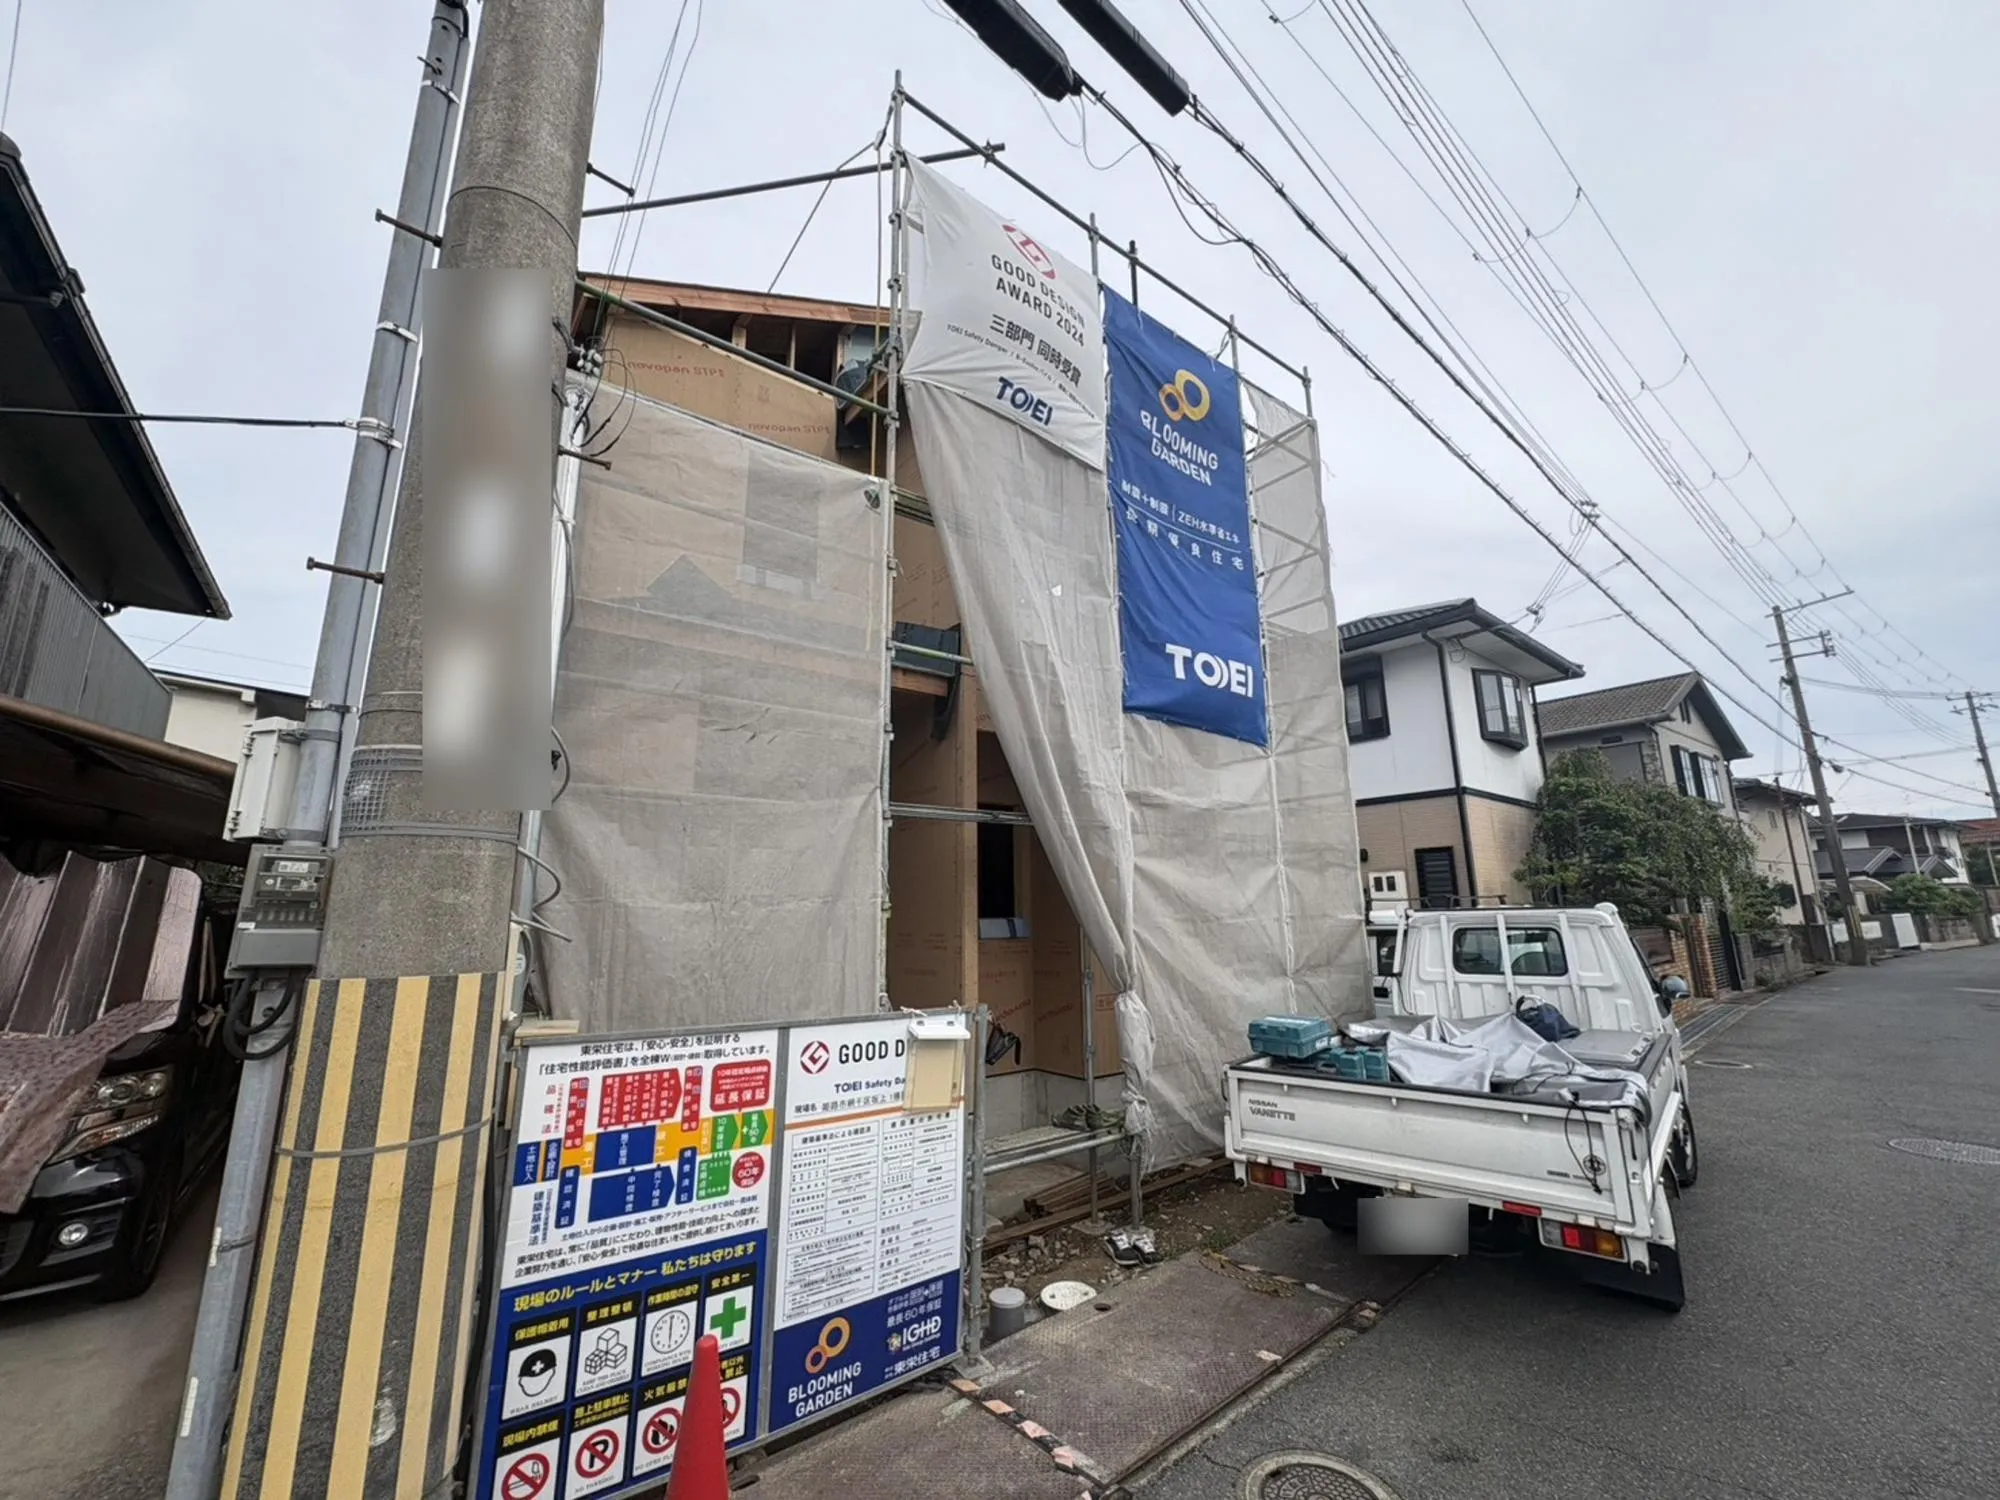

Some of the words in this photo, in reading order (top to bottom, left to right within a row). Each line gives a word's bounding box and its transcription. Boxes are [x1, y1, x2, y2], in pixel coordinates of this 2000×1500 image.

[992, 254, 1036, 288] GOOD
[1040, 281, 1085, 329] DESIGN
[996, 277, 1052, 319] AWARD
[1056, 311, 1084, 347] 2024
[989, 314, 1035, 350] 三部門
[1037, 339, 1082, 389] 同時受賞
[996, 376, 1053, 426] TOEI
[1140, 409, 1219, 471] BLOOMING
[1151, 437, 1212, 487] GARDEN
[1165, 643, 1254, 698] TOEI
[838, 1040, 889, 1065] GOOD
[834, 1081, 862, 1094] TOEI
[865, 1079, 893, 1090] Safety
[1249, 1106, 1297, 1121] VANETTE
[513, 1267, 658, 1313] 現場のルールとマナー
[660, 1241, 757, 1276] 私たちは守ります
[788, 1361, 862, 1404] BLOOMING
[795, 1381, 853, 1418] GARDEN
